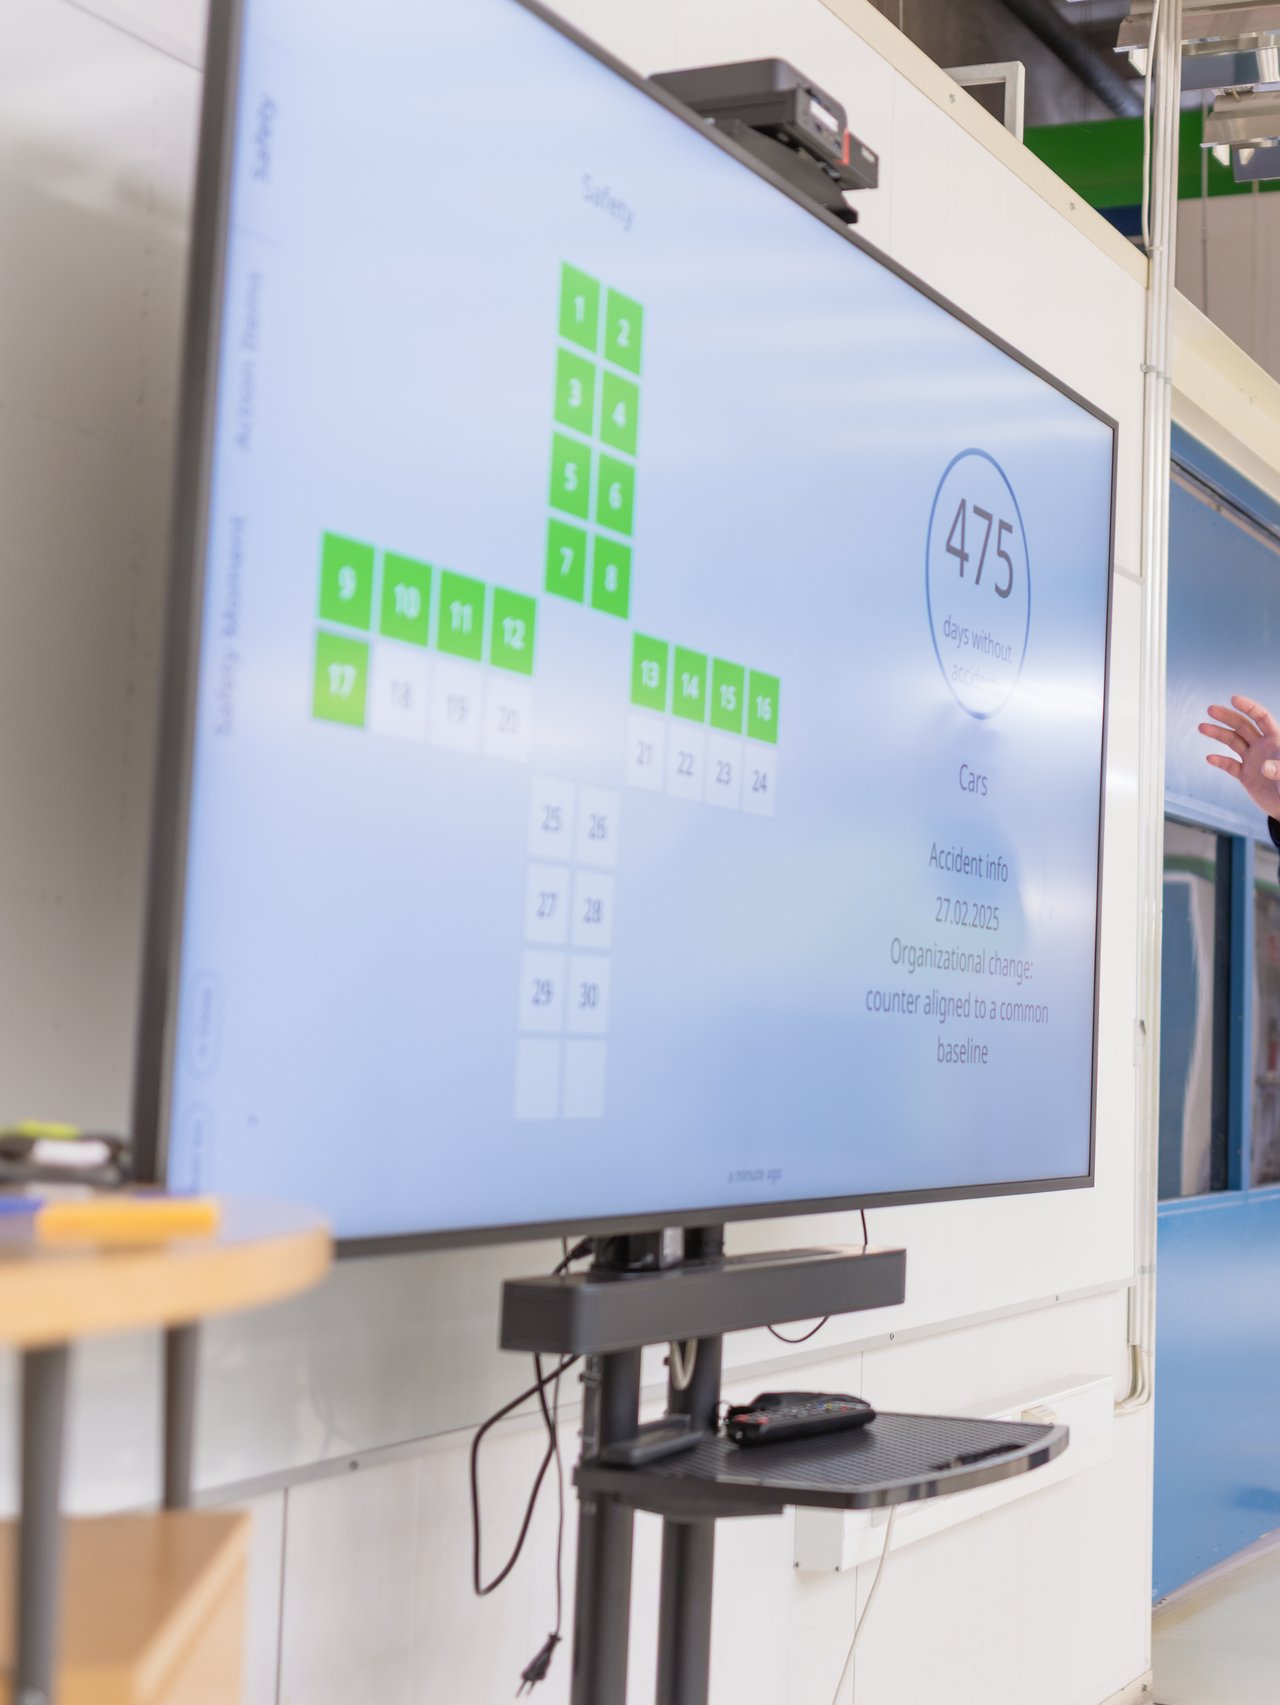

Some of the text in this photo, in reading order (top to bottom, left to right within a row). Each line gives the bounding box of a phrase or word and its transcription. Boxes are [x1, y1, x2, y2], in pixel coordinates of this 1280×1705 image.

[581, 173, 636, 233] Safety
[573, 295, 630, 347] 1 2
[568, 378, 626, 428] 3 4
[564, 462, 623, 510] 5 6
[560, 546, 618, 593] 7 8
[945, 497, 1014, 599] 475
[337, 565, 527, 651] 9 10 11 12
[943, 614, 1012, 664] days without
[327, 662, 519, 734] 17 18 19 20
[640, 659, 772, 721] 13 14 15 16
[636, 740, 768, 793] 21 22 23 24
[959, 763, 988, 796] Cars
[541, 805, 608, 840] 25 26
[929, 842, 1009, 882] Accident info
[536, 891, 603, 924] 27 28
[935, 896, 1000, 932] 27.02.2025
[890, 937, 1033, 986] Organizational change:
[531, 977, 598, 1009] 29 30
[865, 988, 1049, 1024] counter aligned to a common
[937, 1036, 989, 1064] baseline
